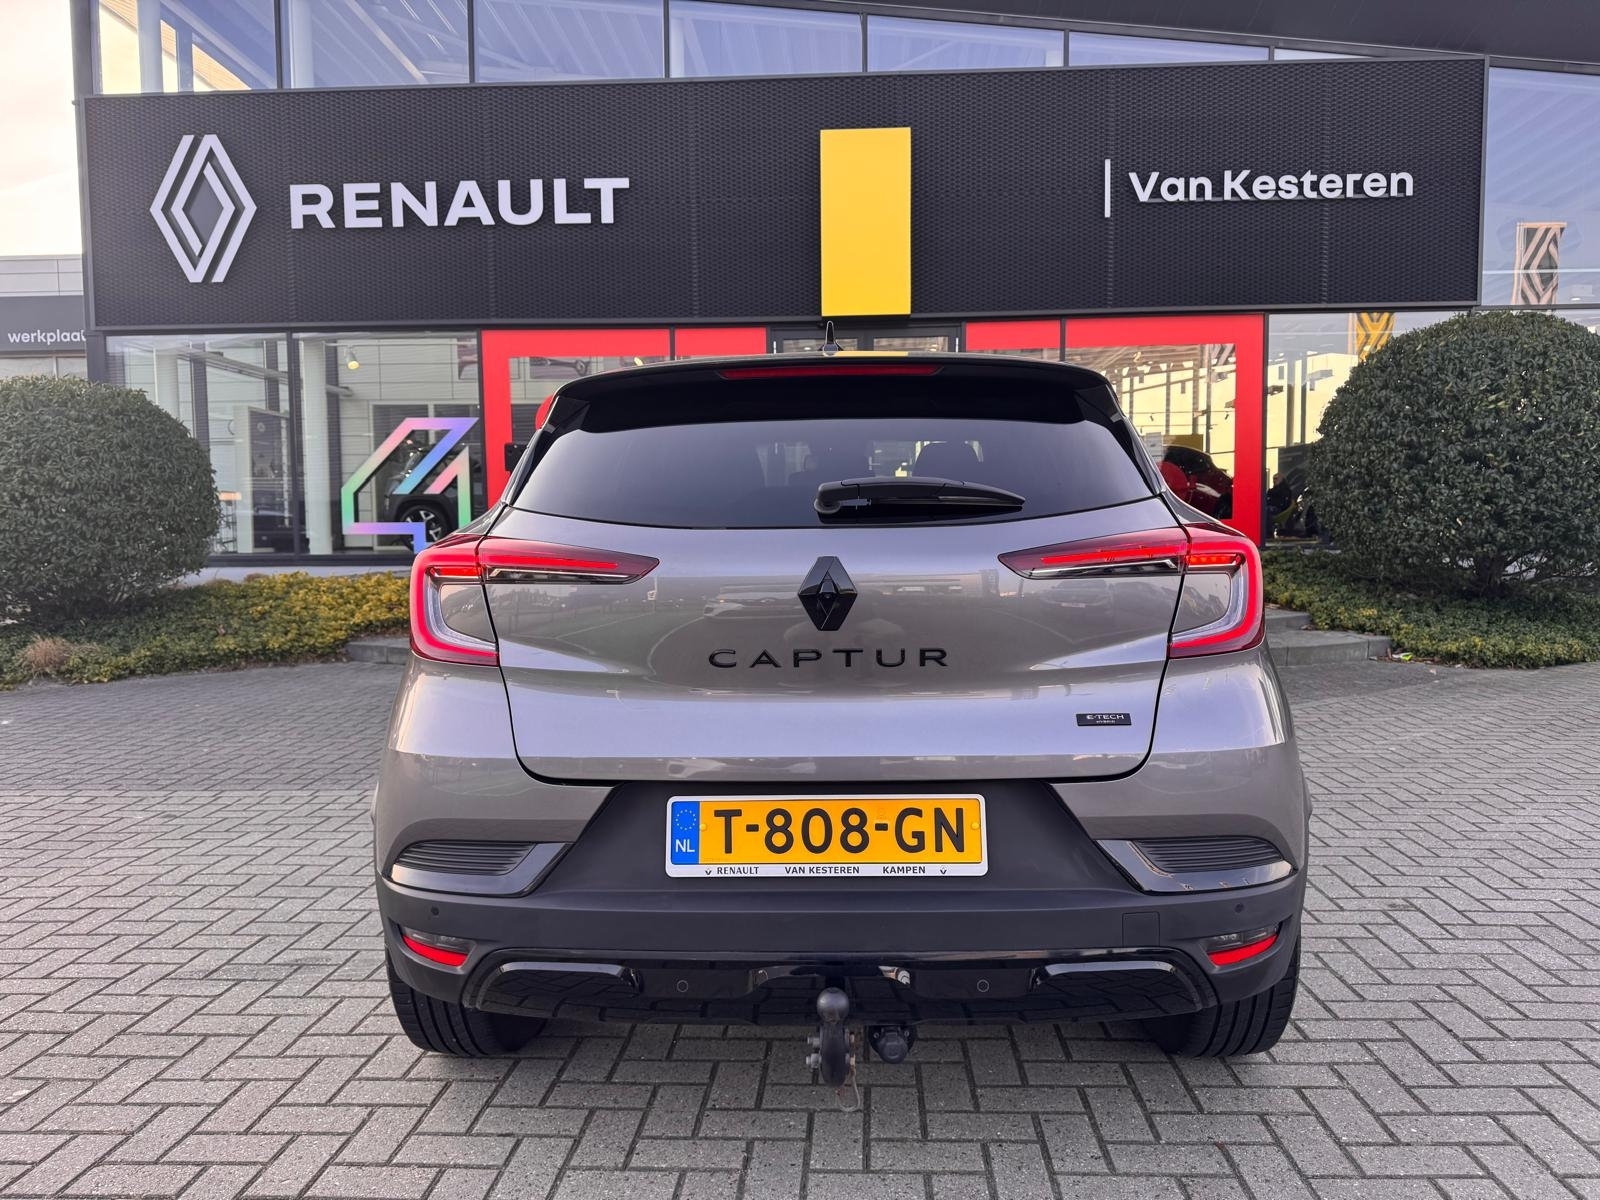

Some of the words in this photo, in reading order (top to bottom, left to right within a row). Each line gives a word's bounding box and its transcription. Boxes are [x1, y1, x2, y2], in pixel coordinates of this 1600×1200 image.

[1128, 172, 1213, 202] Van
[1223, 169, 1414, 200] Kesteren
[289, 177, 630, 229] RENAULT
[708, 648, 949, 668] CAPTUR
[713, 807, 965, 854] T-808-GN
[675, 838, 696, 853] NL
[716, 866, 760, 875] RENAULT
[784, 866, 805, 875] VAN
[808, 866, 860, 875] KESTEREN
[882, 865, 926, 875] KAMPEN
